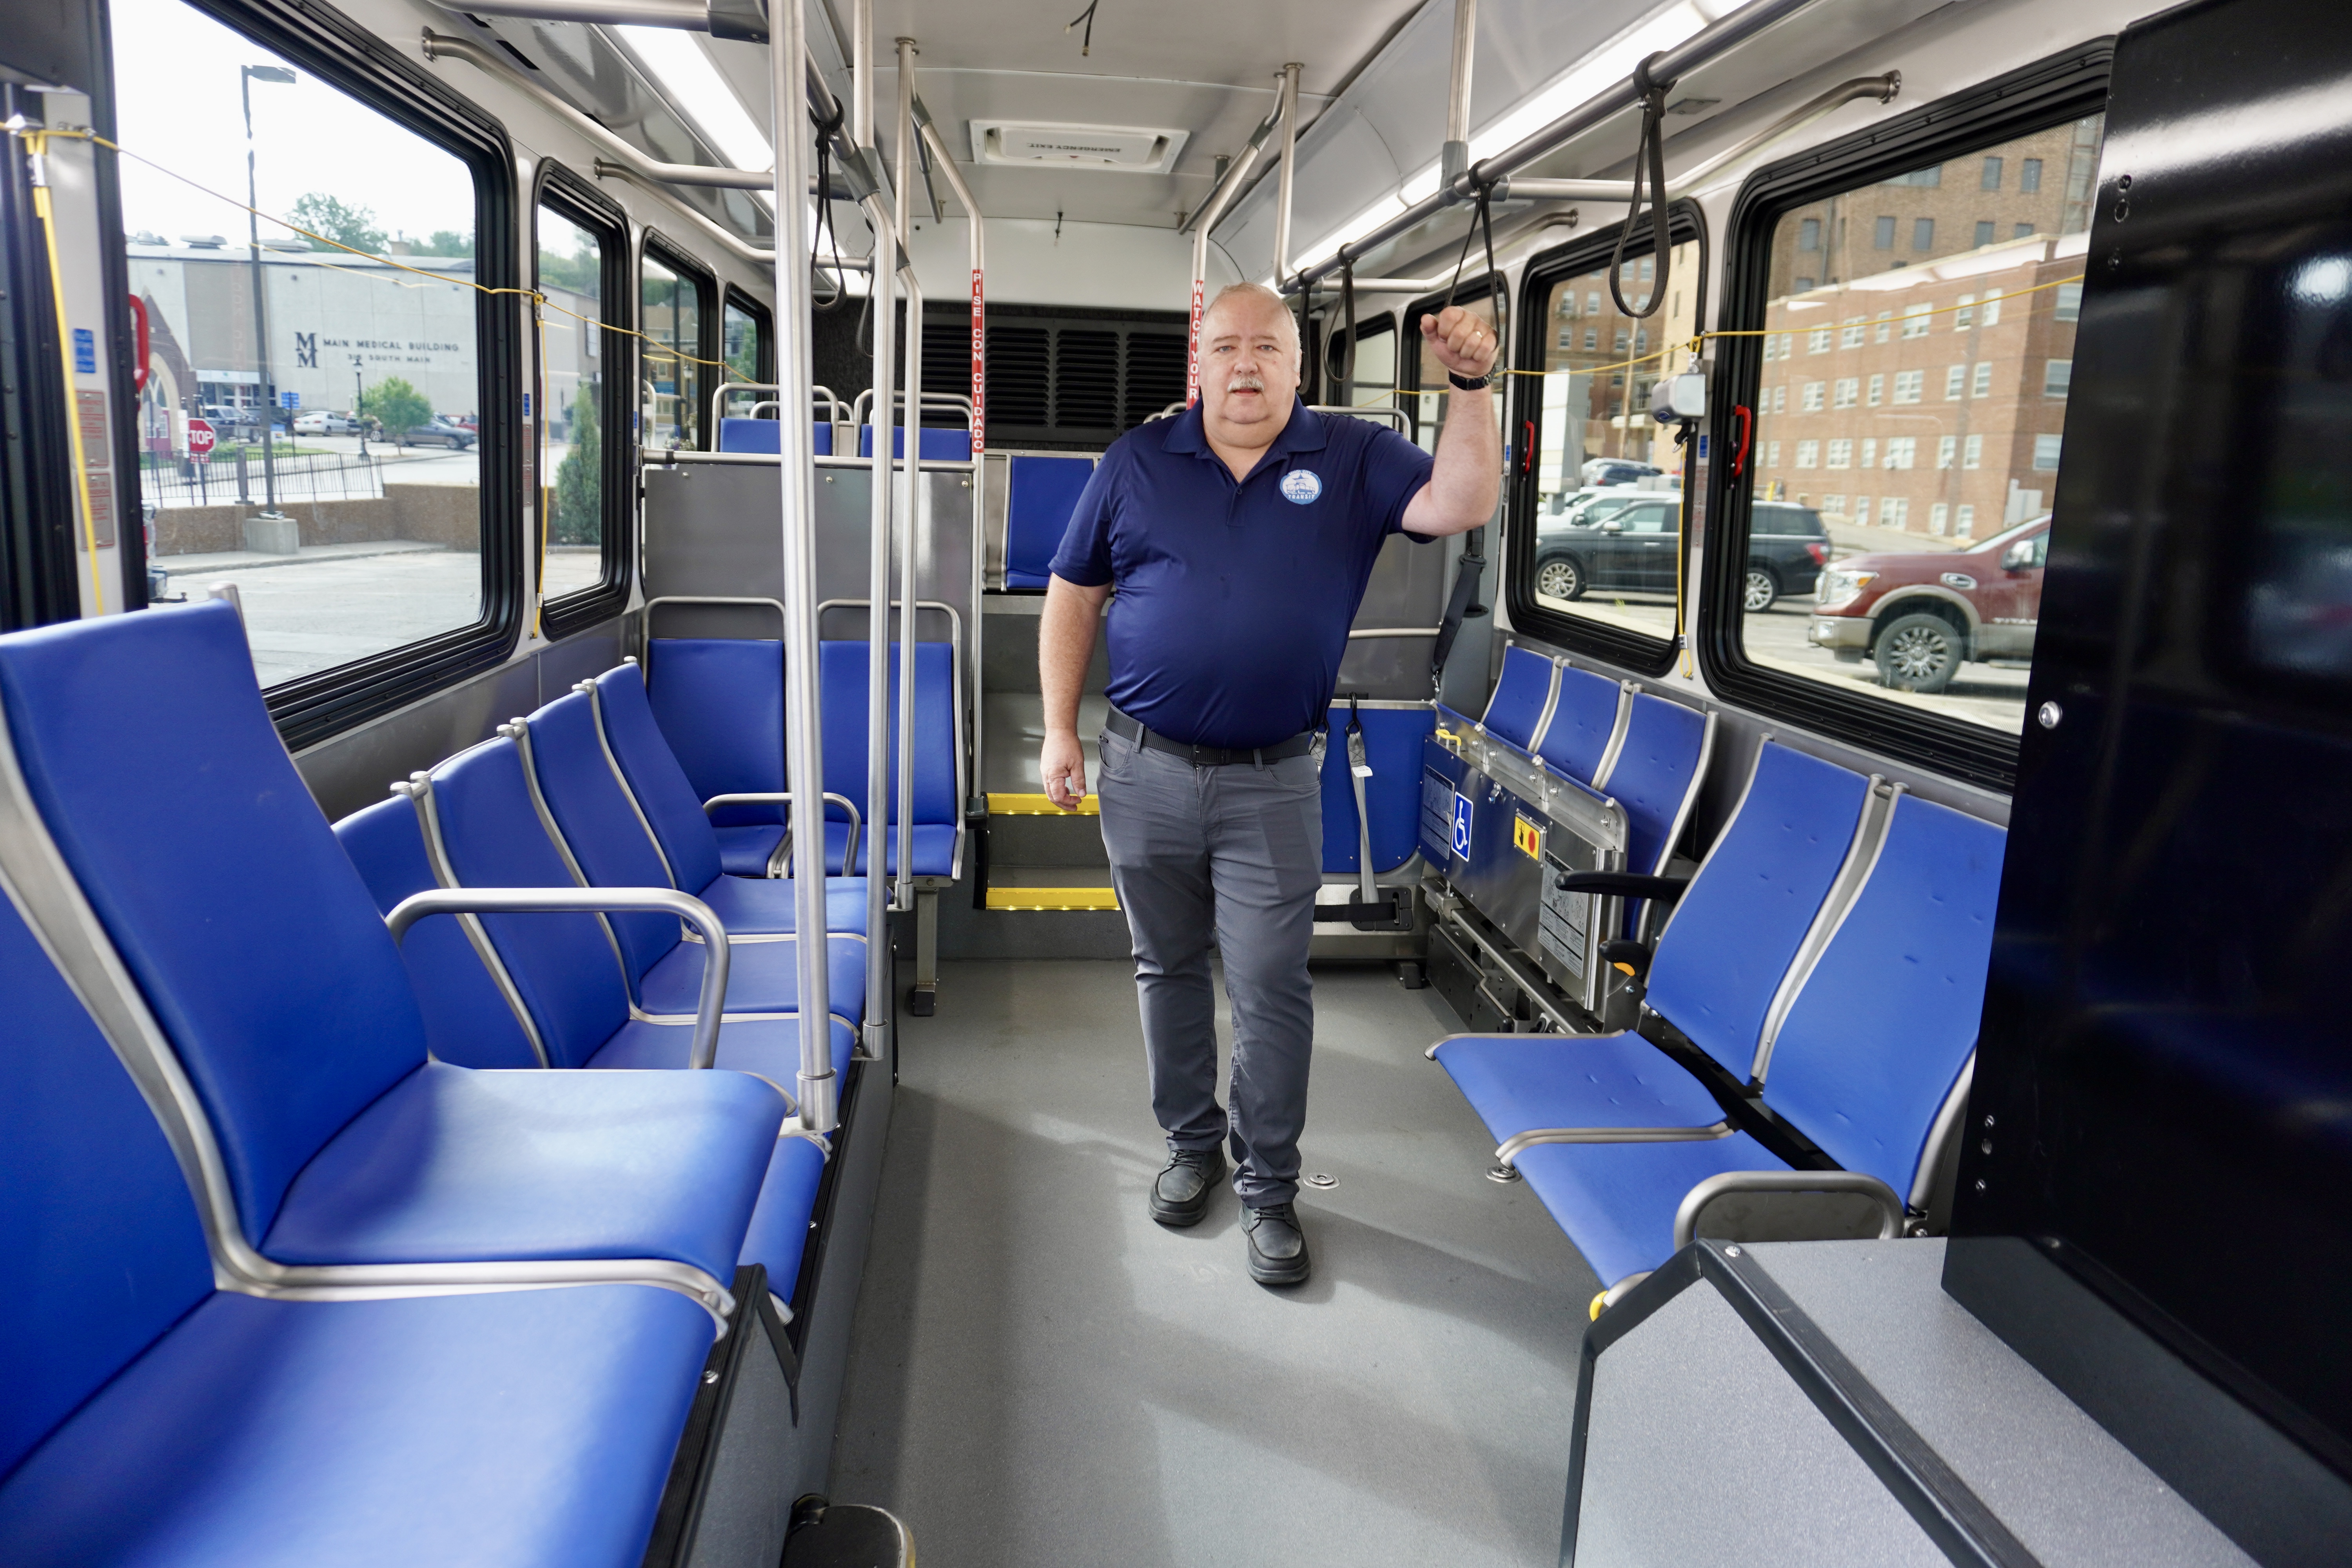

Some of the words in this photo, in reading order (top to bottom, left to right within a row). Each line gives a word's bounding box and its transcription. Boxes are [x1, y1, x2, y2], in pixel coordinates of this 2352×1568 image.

[973, 273, 982, 317] PISE
[1191, 282, 1204, 343] WATCH
[323, 339, 349, 347] MAIN
[357, 340, 402, 350] MEDICAL
[409, 342, 459, 352] BUILDING
[973, 328, 982, 361] CON
[1189, 350, 1198, 399] YOUR
[973, 372, 984, 449] CUIDADO
[189, 430, 213, 445] TOP
